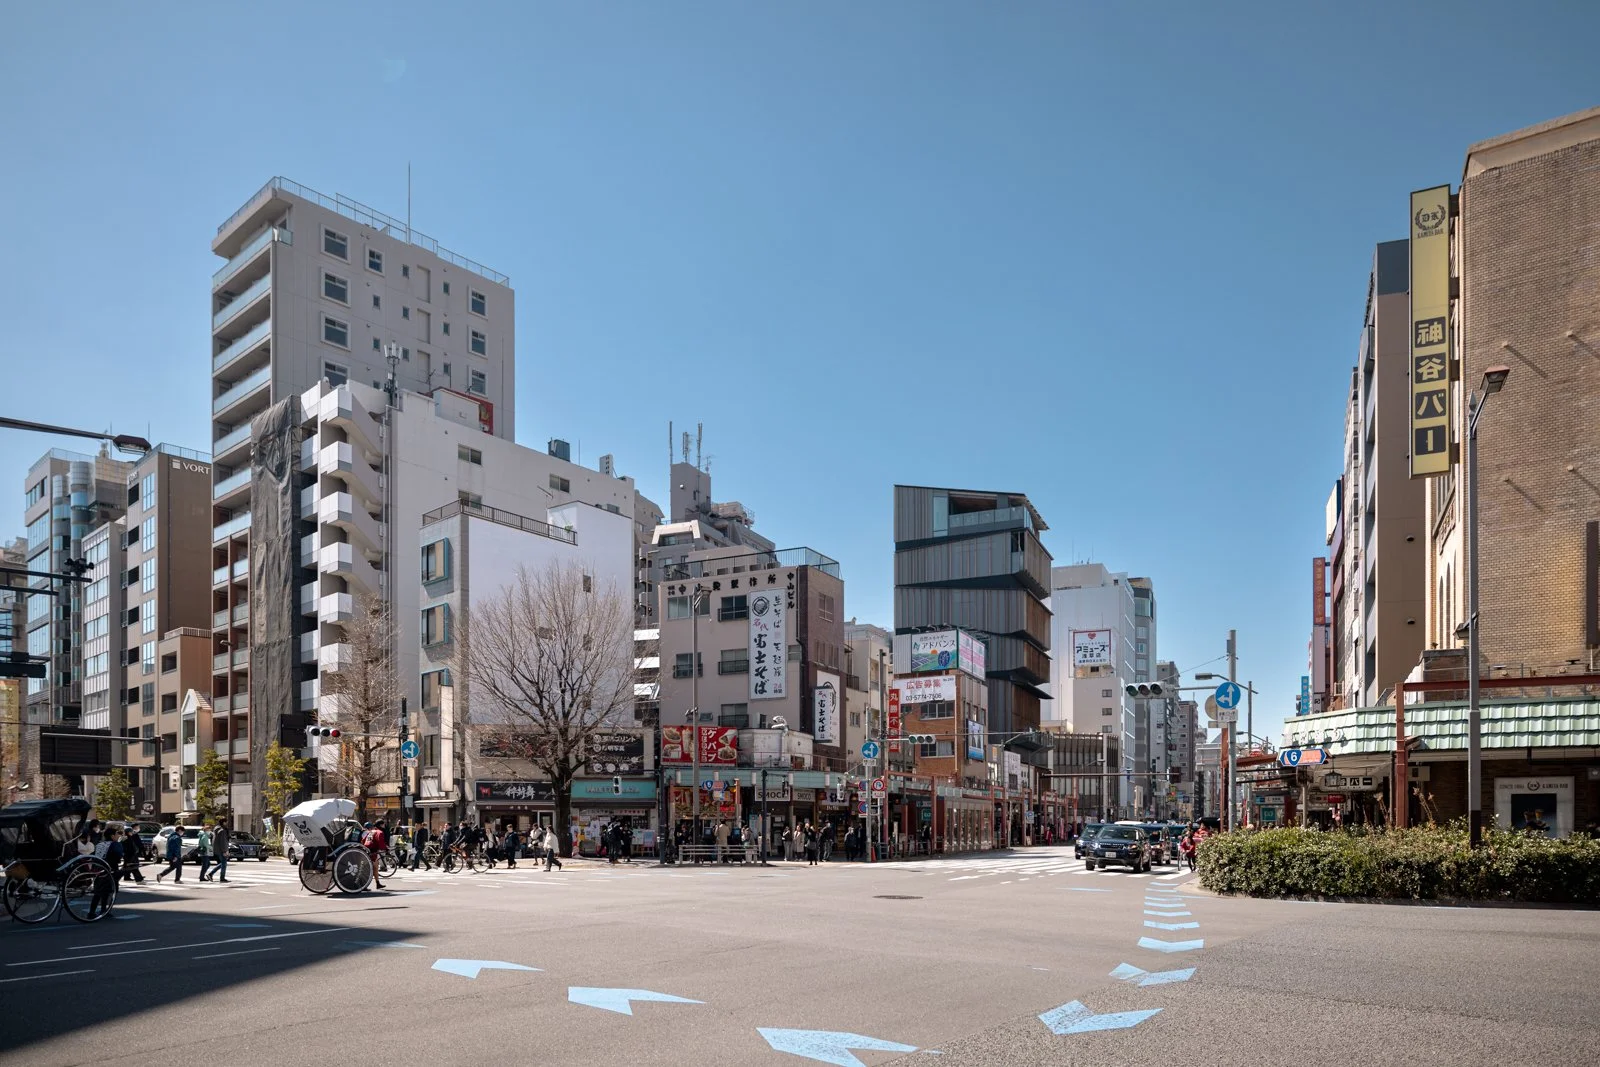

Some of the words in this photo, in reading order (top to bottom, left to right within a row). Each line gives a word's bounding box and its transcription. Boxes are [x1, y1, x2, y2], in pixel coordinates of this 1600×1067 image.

[1417, 322, 1444, 451] 神谷バー
[182, 462, 211, 475] VORT
[786, 572, 796, 609] 中山ビル
[921, 640, 956, 650] アドバンス
[1075, 644, 1109, 654] アミューズ
[753, 634, 769, 695] 富士そば
[906, 678, 941, 690] 広告募集
[707, 729, 717, 762] ケバブ
[1290, 751, 1298, 762] 6
